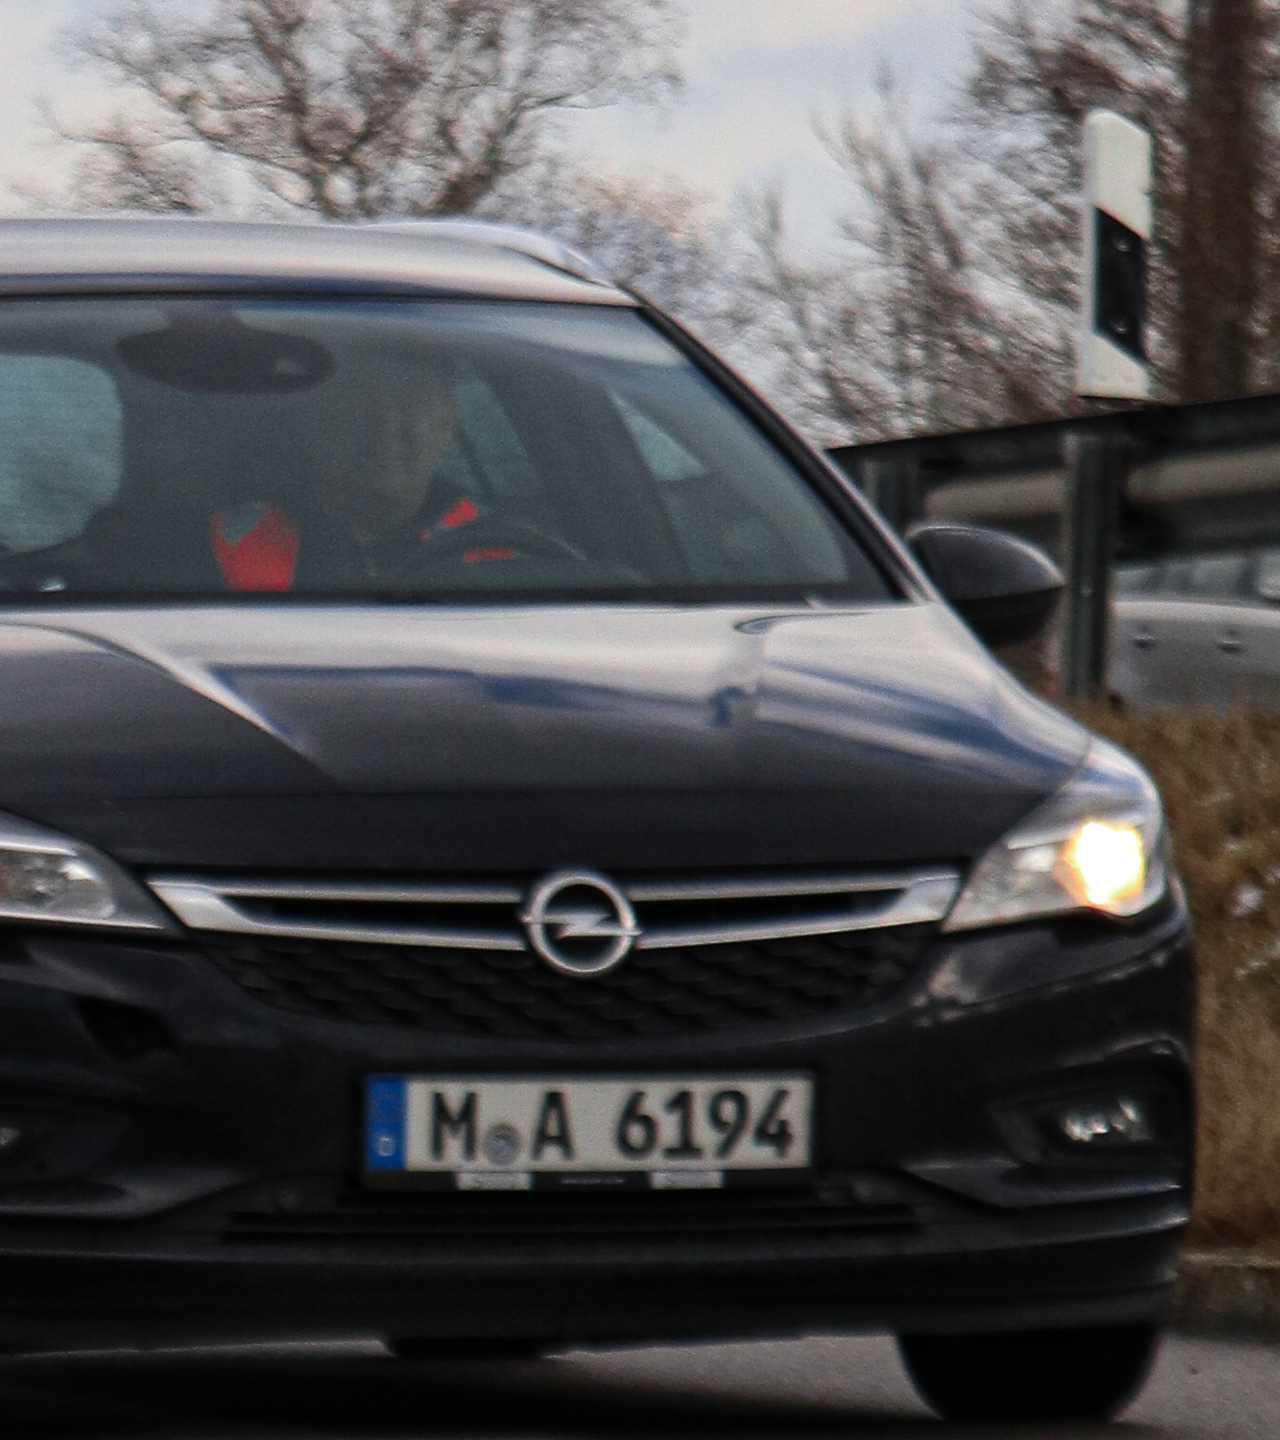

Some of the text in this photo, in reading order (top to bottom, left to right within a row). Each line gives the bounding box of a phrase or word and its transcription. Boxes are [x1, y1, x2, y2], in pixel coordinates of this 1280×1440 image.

[430, 1089, 793, 1160] M A 6194
